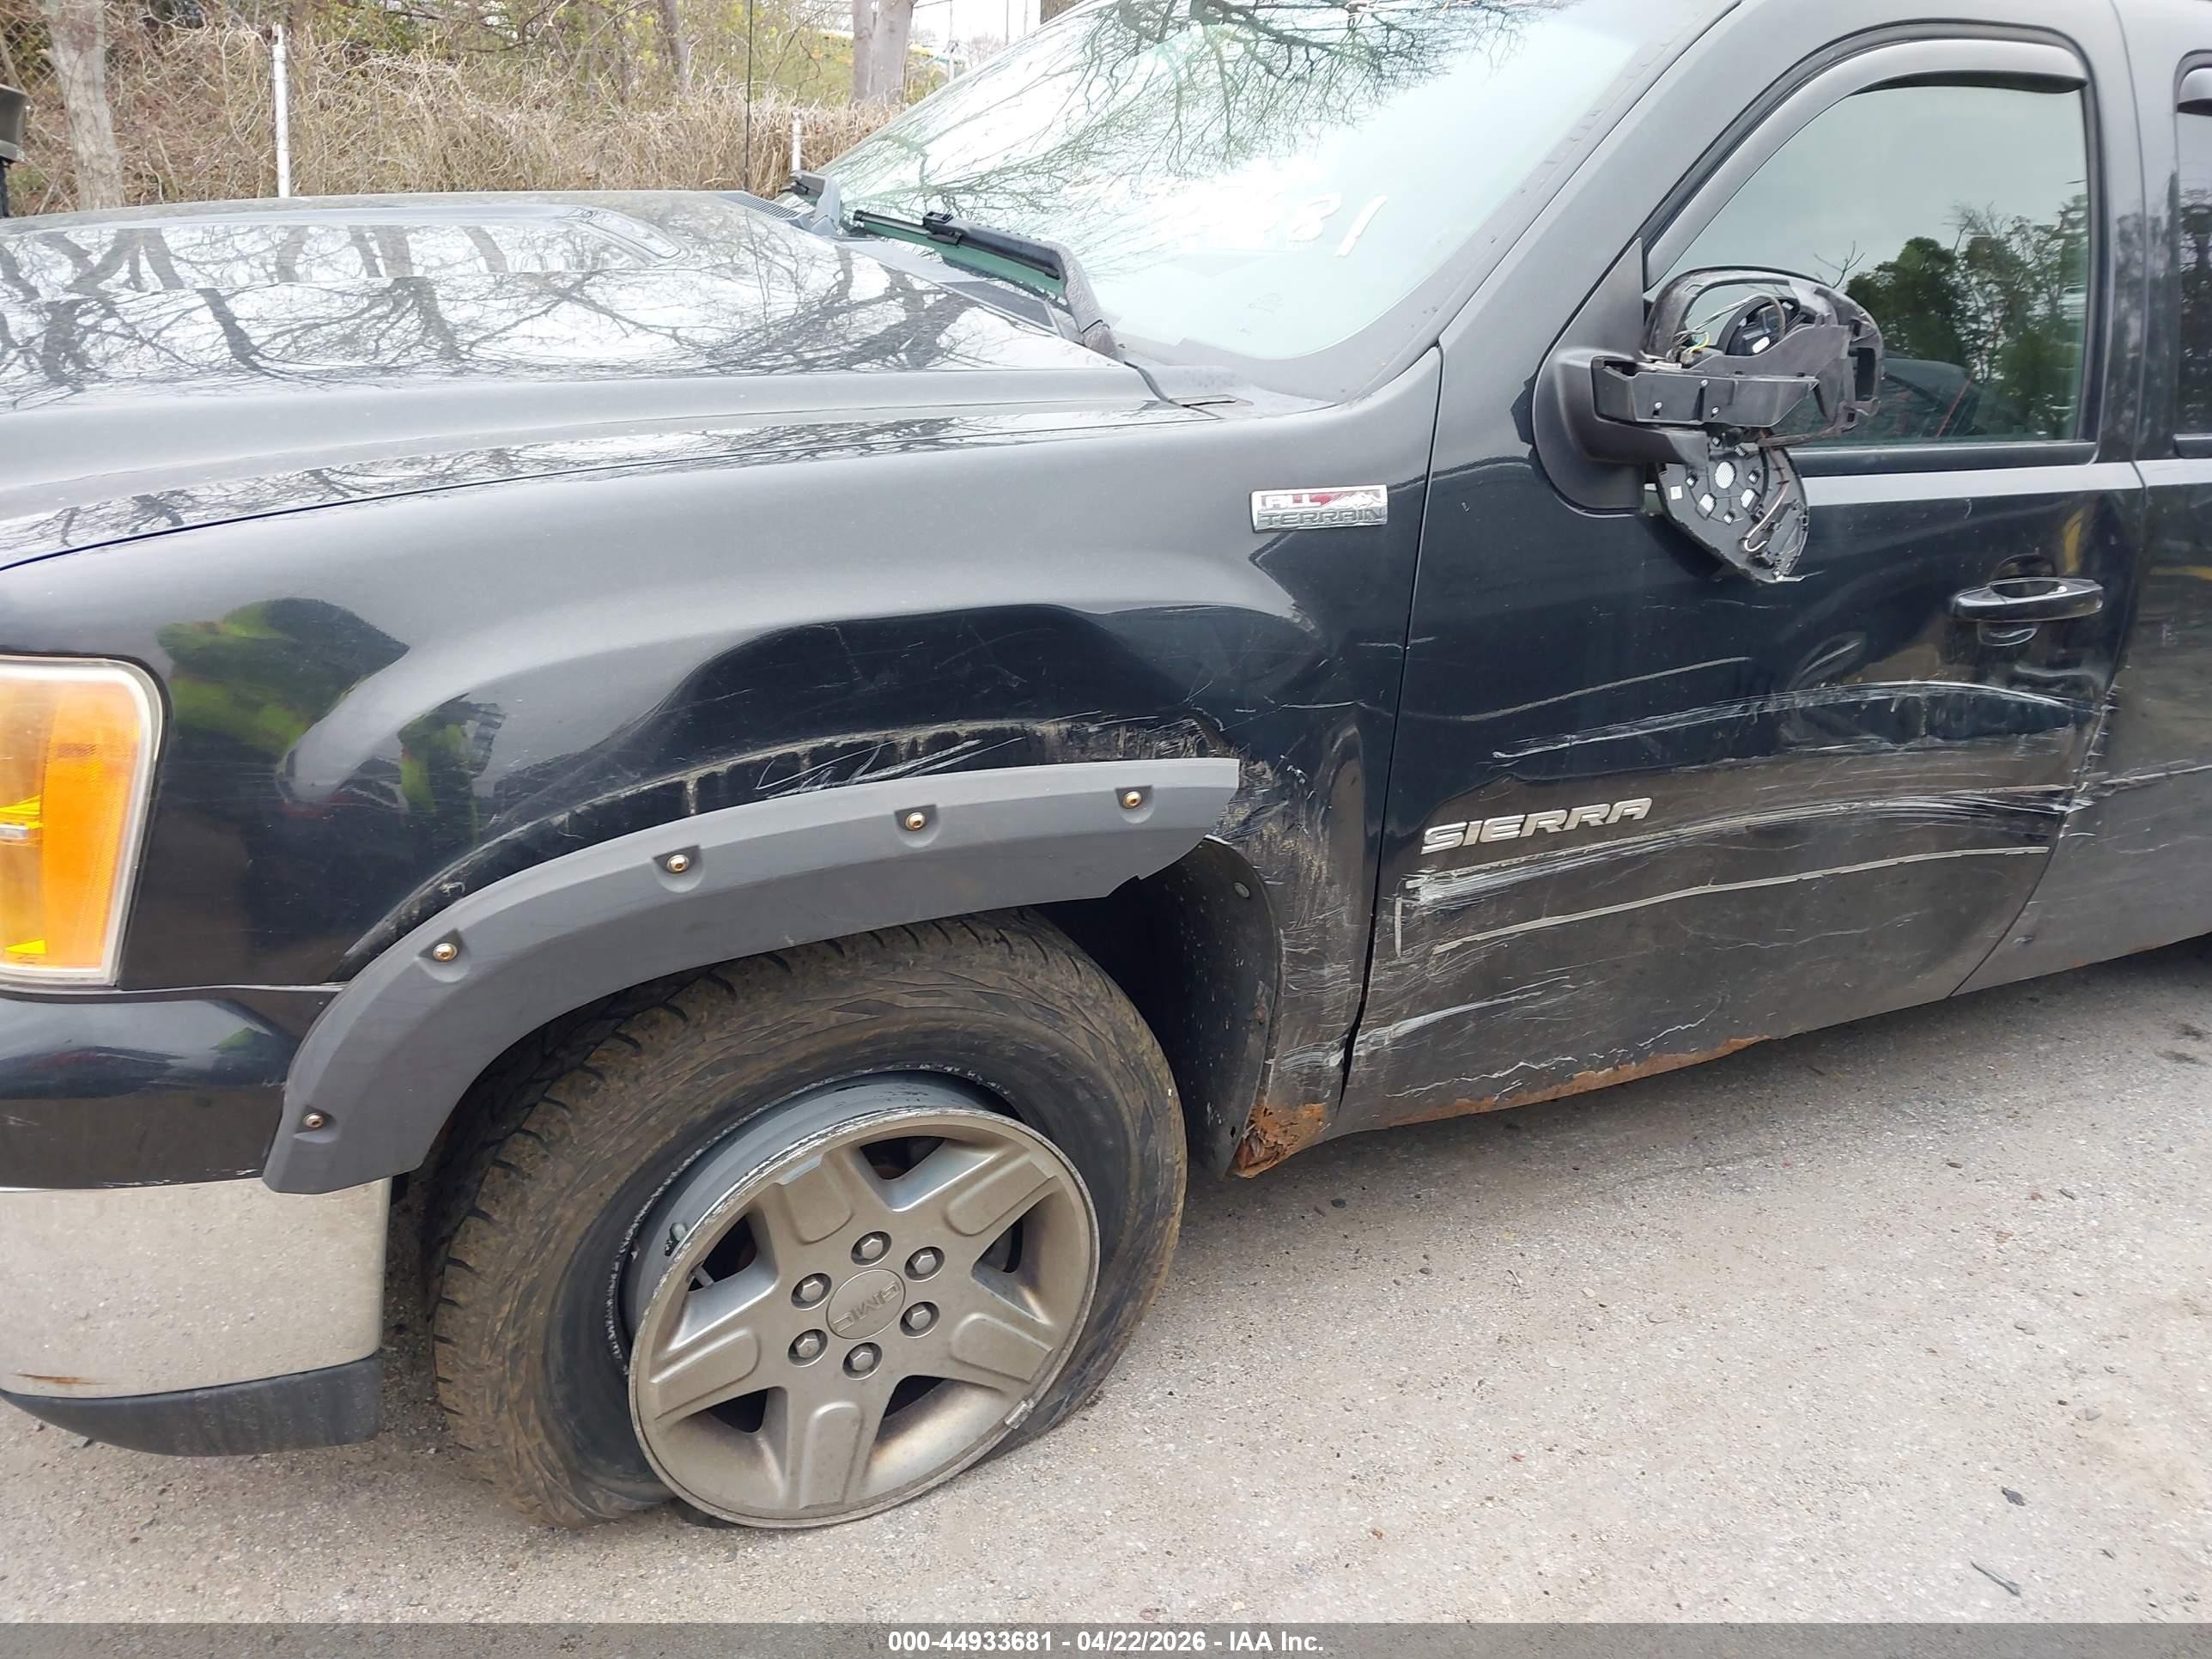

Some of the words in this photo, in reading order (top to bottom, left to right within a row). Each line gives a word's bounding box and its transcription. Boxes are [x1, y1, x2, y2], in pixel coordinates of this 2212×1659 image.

[1259, 508, 1386, 526] TERRAIN
[1264, 493, 1323, 508] ALL
[1420, 797, 1653, 855] SIERRA
[832, 1280, 901, 1333] GMC
